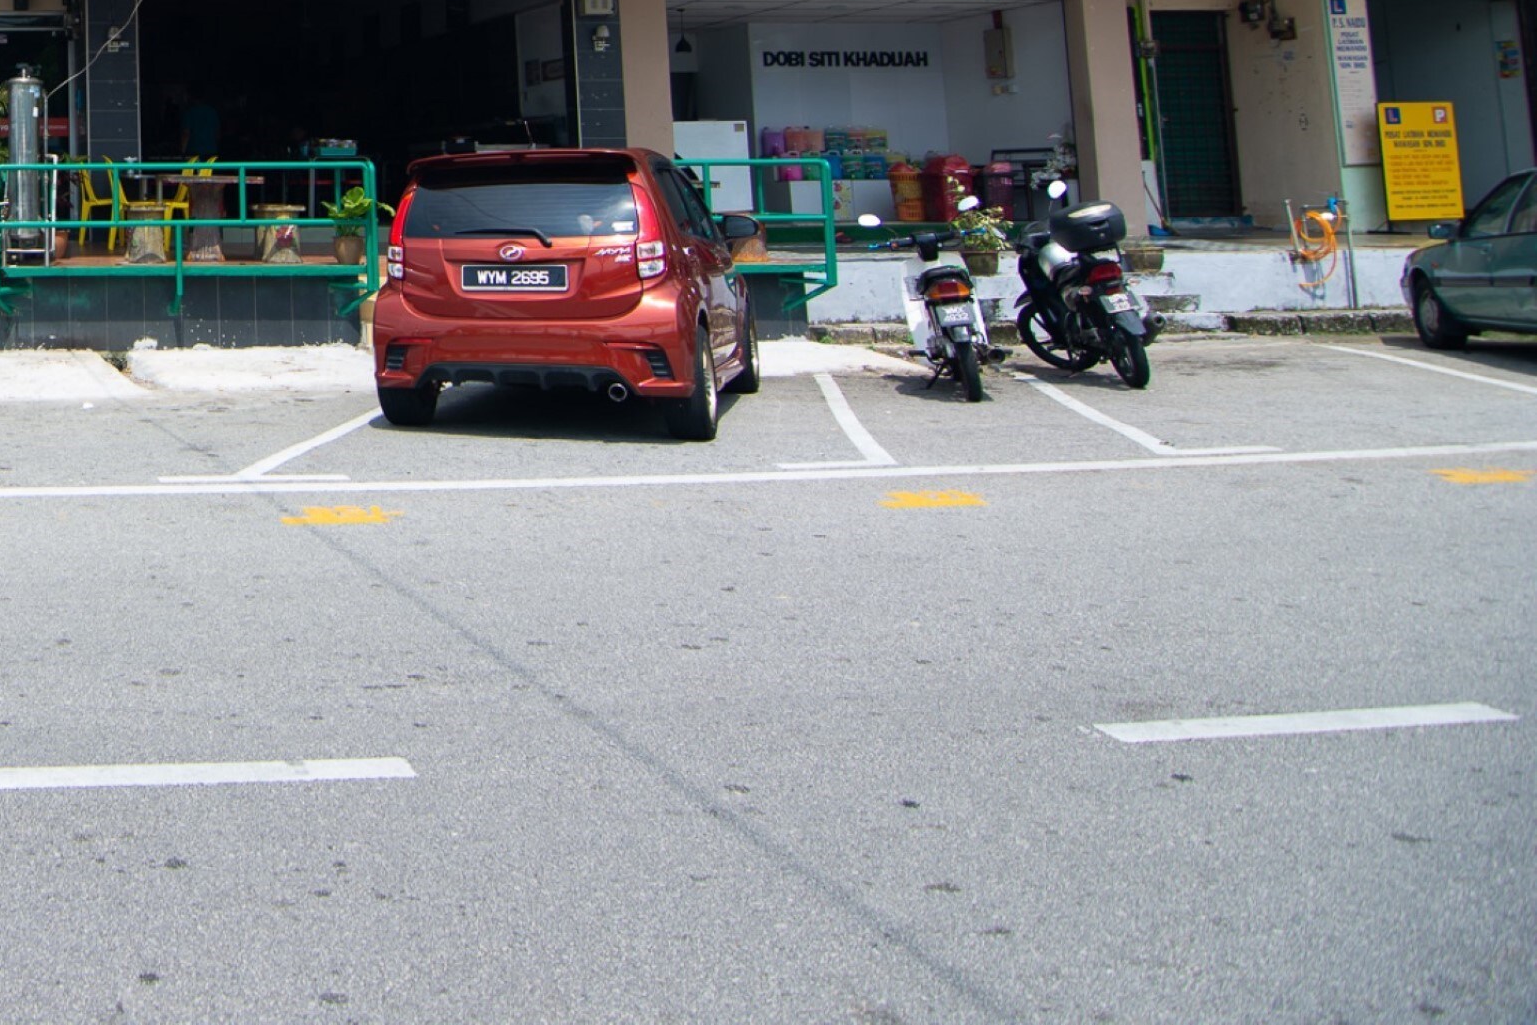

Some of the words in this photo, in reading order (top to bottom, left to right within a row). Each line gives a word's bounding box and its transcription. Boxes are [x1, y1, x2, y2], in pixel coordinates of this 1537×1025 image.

[763, 51, 805, 67] DOBI
[809, 51, 840, 67] SITI
[844, 51, 929, 67] KHADIJAH
[477, 270, 507, 285] WYM
[511, 271, 550, 285] 2695
